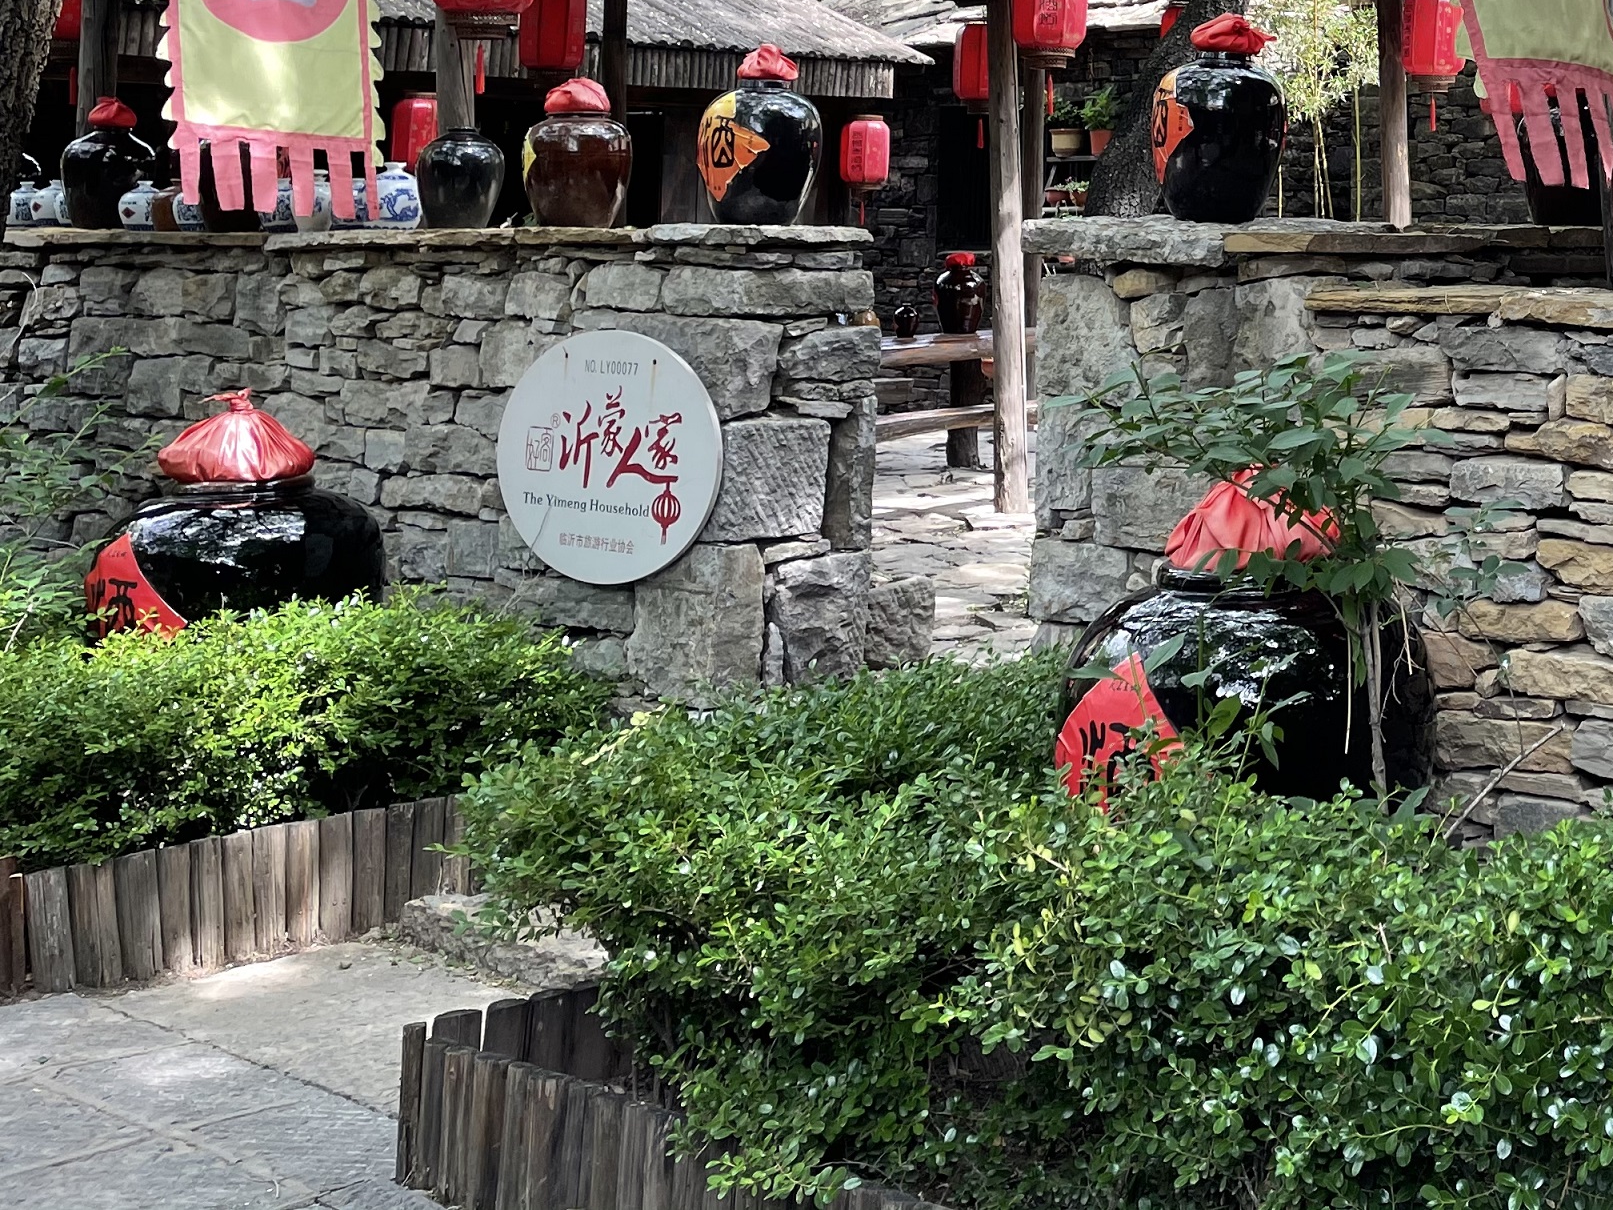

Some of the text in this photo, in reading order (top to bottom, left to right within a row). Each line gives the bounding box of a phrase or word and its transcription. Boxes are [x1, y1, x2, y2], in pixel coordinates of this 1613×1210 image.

[584, 359, 639, 376] NO. LY00077
[559, 385, 682, 489] 沂蒙人家
[523, 491, 650, 518] The Yimeng Household
